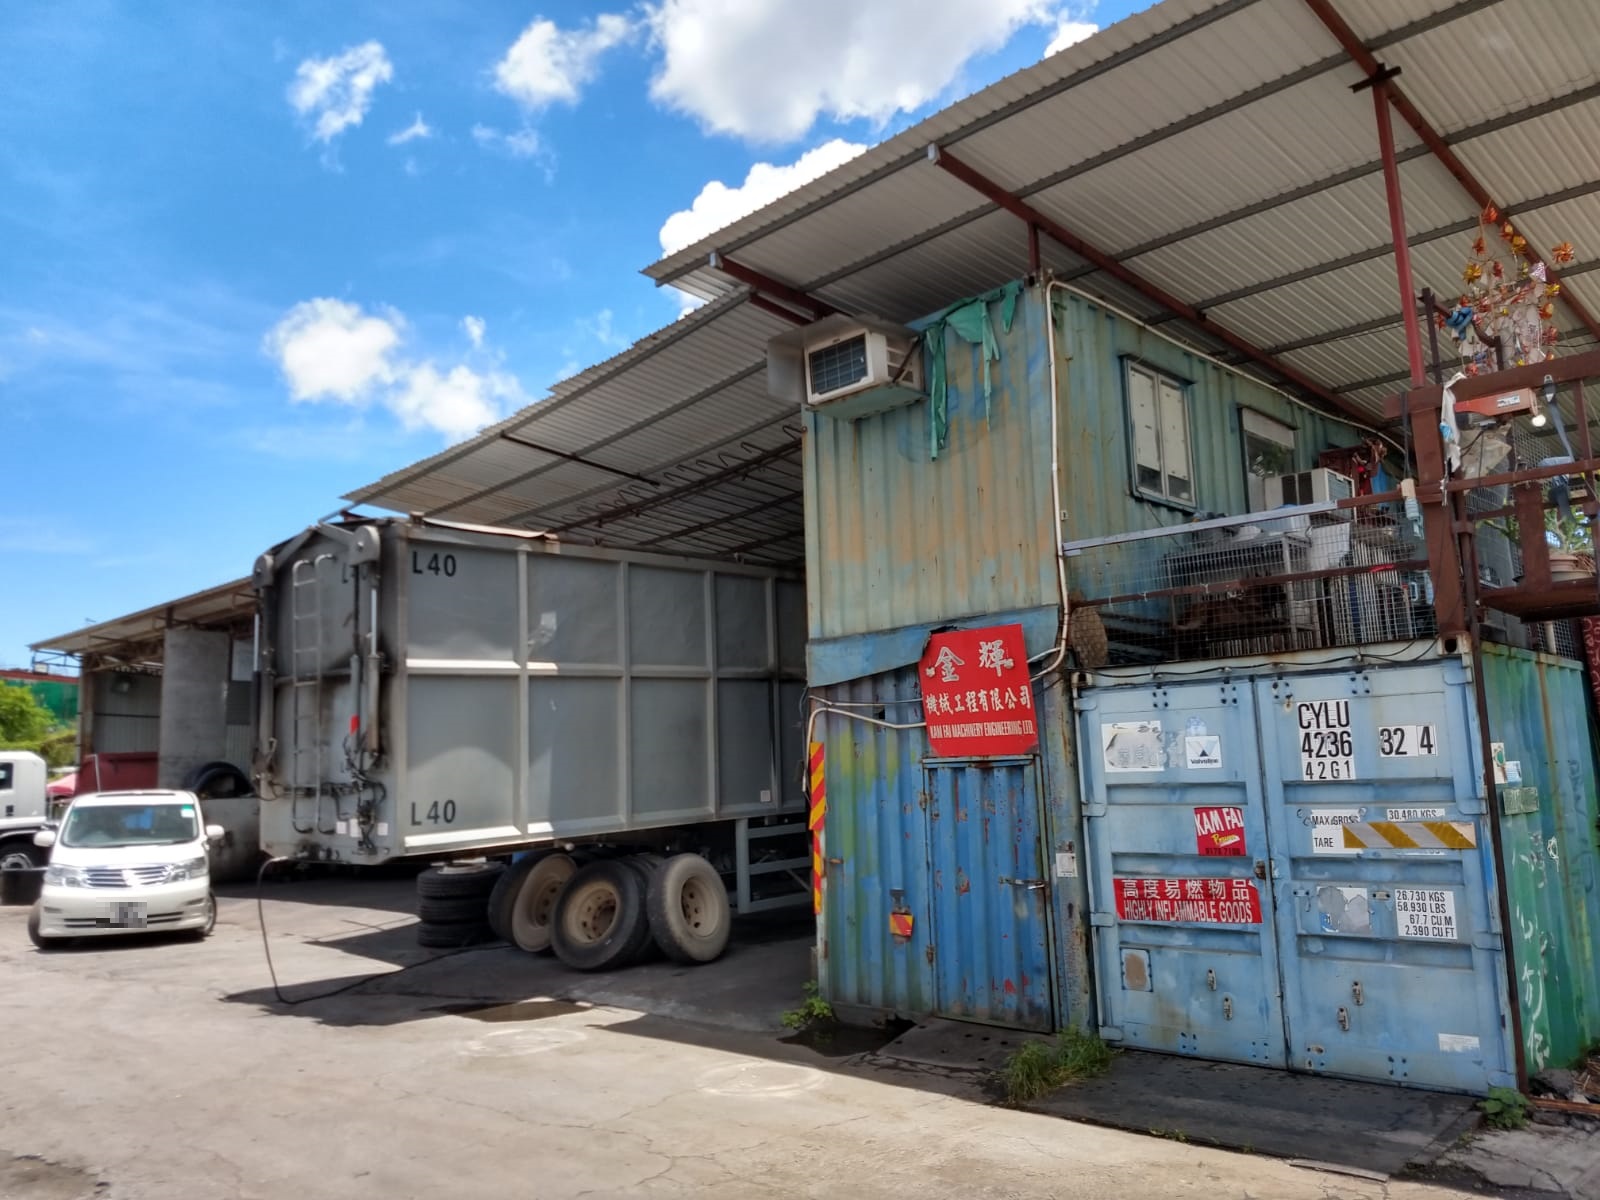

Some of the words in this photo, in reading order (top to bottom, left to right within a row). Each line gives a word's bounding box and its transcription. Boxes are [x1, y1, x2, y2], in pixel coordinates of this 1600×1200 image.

[412, 550, 457, 577] L40
[926, 685, 1031, 716] 機械工程有限公司
[1298, 700, 1350, 729] CYLU
[930, 725, 943, 739] KAM
[951, 723, 984, 737] MACHINERY
[984, 720, 1022, 736] ENGINEERING
[1379, 727, 1407, 756] 32
[1419, 725, 1434, 754] 4
[1301, 730, 1353, 759] 4236
[1305, 760, 1351, 780] 42G1
[411, 799, 457, 827] L40
[1194, 810, 1225, 836] KAM
[1222, 807, 1244, 830] FAI
[1314, 837, 1335, 848] TARE
[1121, 878, 1251, 901] 高度易燃物品
[1428, 891, 1446, 903] KGS
[1124, 899, 1154, 921] HIGHLY
[1154, 900, 1218, 923] INFLAMMABLE
[1218, 901, 1253, 924] GOODS
[1429, 902, 1447, 914] LBS
